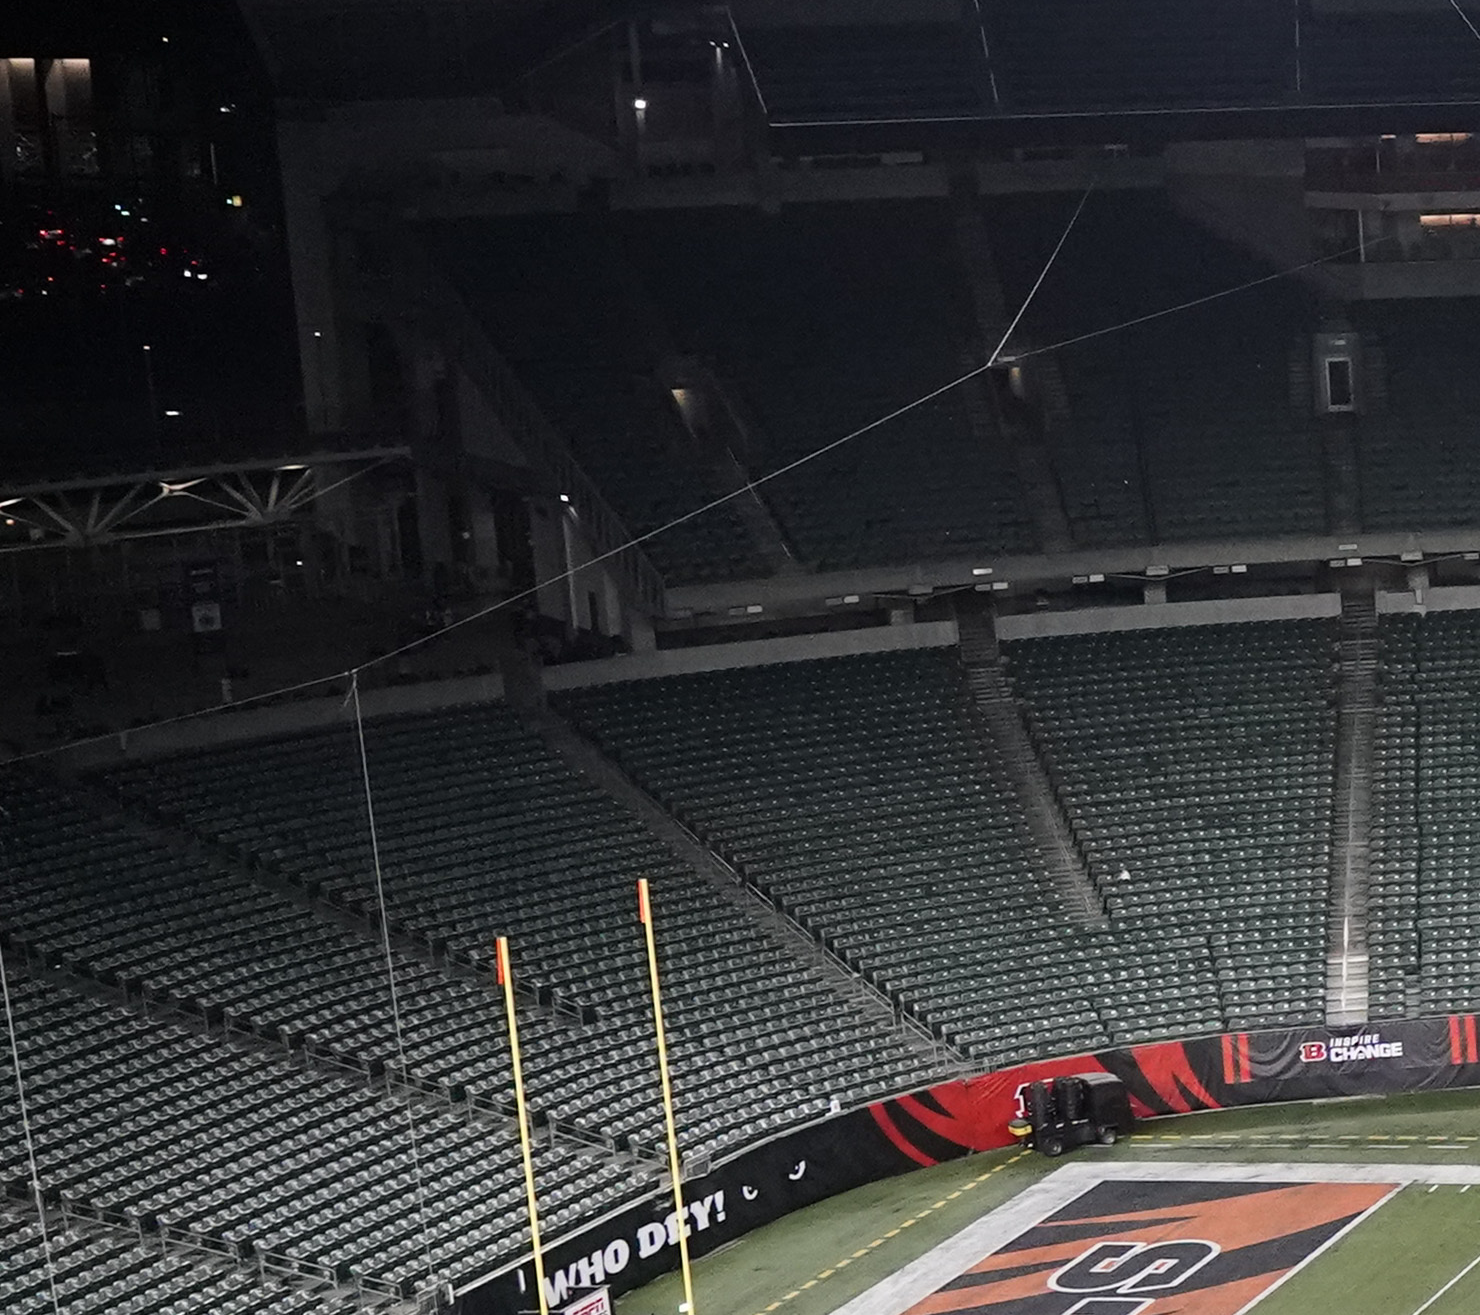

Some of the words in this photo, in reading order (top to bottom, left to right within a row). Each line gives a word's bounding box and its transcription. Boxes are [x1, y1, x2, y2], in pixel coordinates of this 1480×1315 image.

[1329, 1033, 1380, 1048] INSPIRE
[1329, 1042, 1403, 1063] CHANGE
[544, 1238, 630, 1309] WHO
[636, 1189, 726, 1260] DEY!
